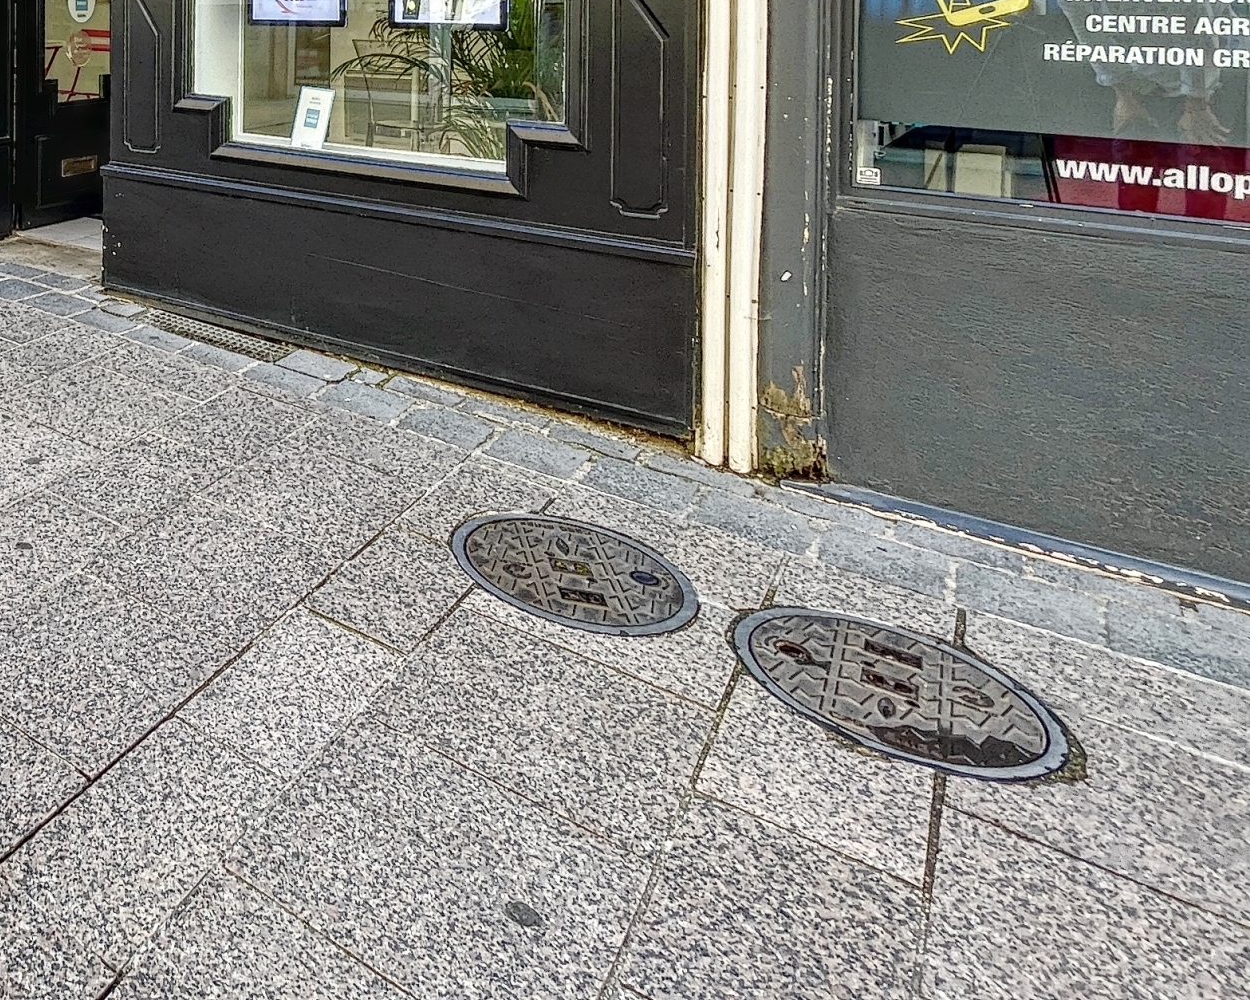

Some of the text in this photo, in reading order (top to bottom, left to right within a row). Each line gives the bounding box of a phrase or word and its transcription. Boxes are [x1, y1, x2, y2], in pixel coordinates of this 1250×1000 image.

[1085, 14, 1250, 36] CENTRE AGR
[1043, 40, 1250, 68] RÉPARATION GR
[1056, 158, 1250, 200] www.allop
